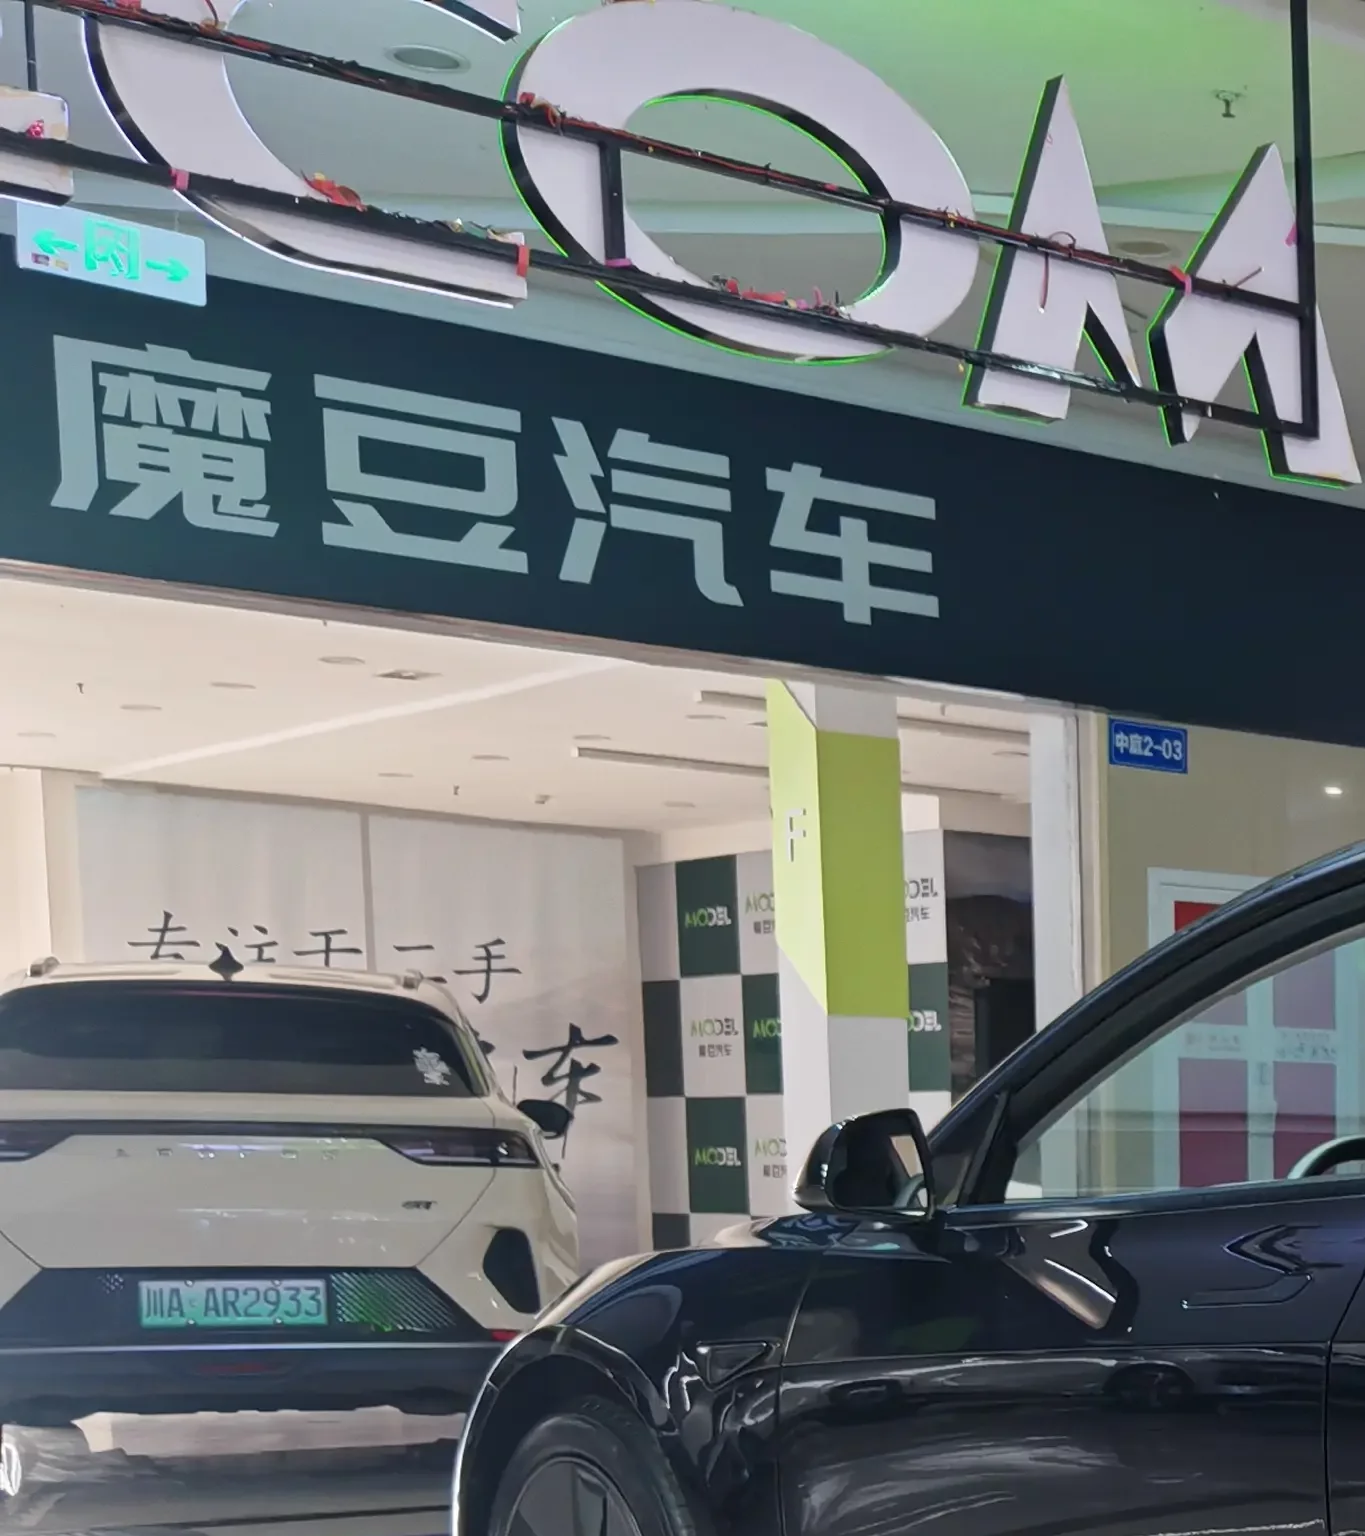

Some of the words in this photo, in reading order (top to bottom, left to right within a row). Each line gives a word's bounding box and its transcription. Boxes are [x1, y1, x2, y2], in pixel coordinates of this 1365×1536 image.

[50, 334, 941, 626] 魔豆汽车
[1115, 731, 1183, 761] 中庭2-03
[685, 906, 732, 928] MODEL
[691, 1018, 739, 1038] MODEL
[694, 1147, 741, 1167] MODEL
